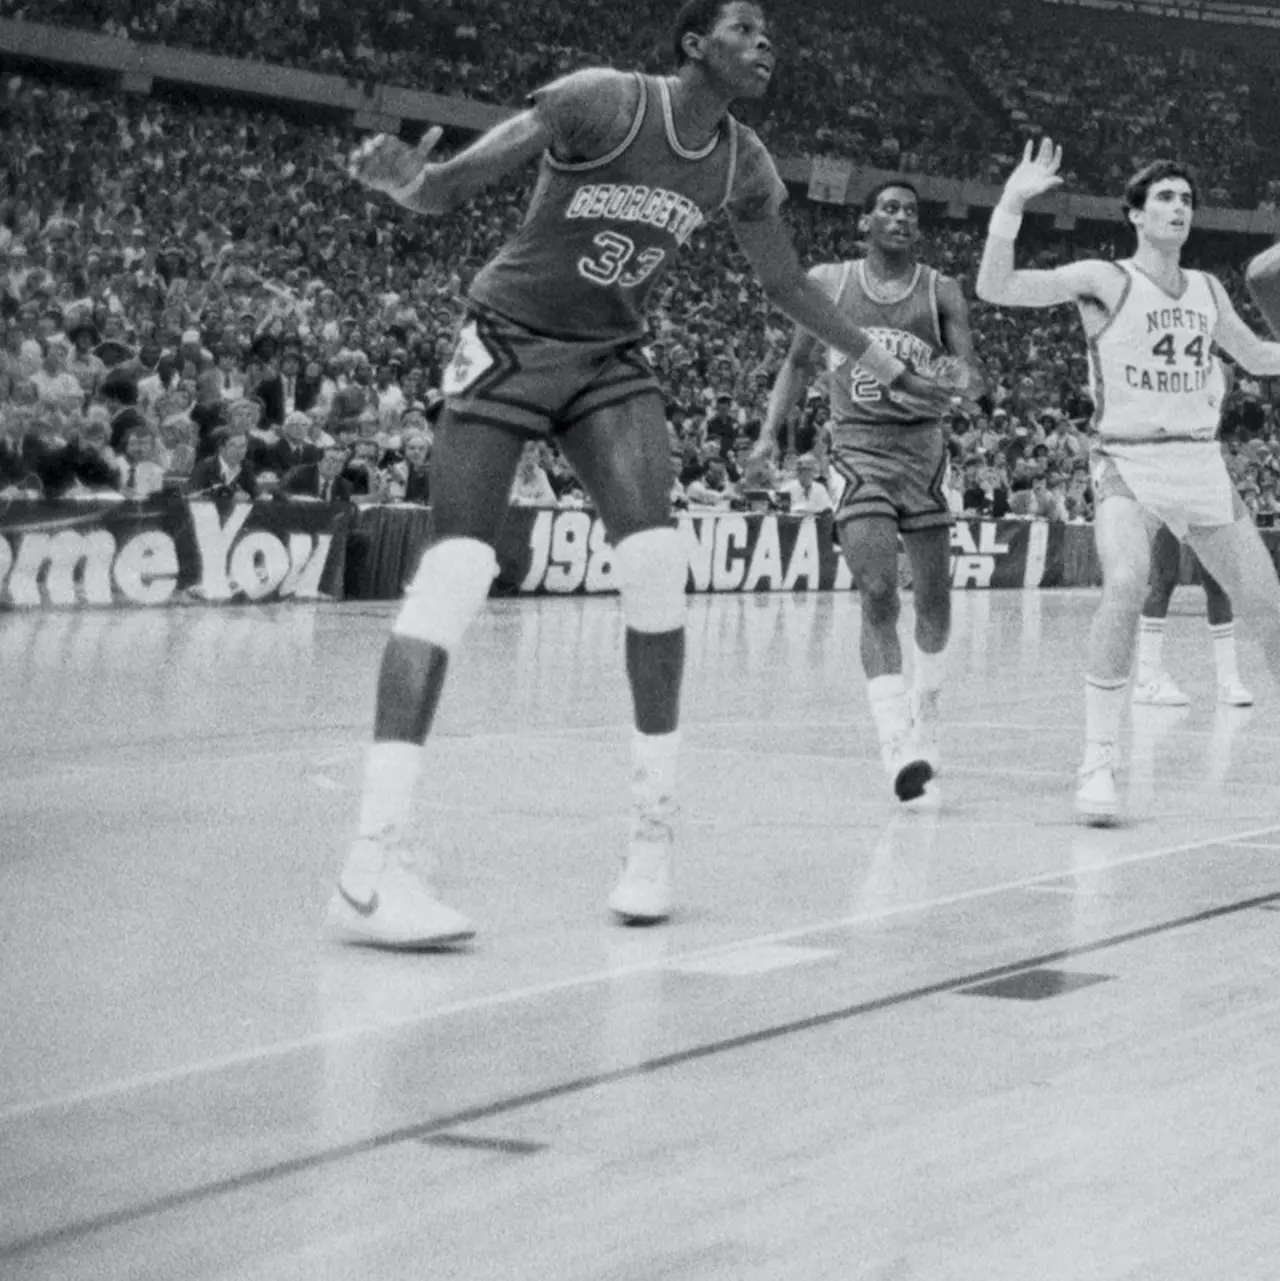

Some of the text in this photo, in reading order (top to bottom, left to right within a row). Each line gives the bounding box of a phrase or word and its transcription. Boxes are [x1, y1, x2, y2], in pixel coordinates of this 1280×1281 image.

[577, 230, 665, 288] 33
[1146, 307, 1209, 333] NORTH
[1152, 333, 1206, 367] 44
[0, 501, 333, 605] me You
[520, 510, 621, 593] 198
[678, 515, 821, 592] NCAA
